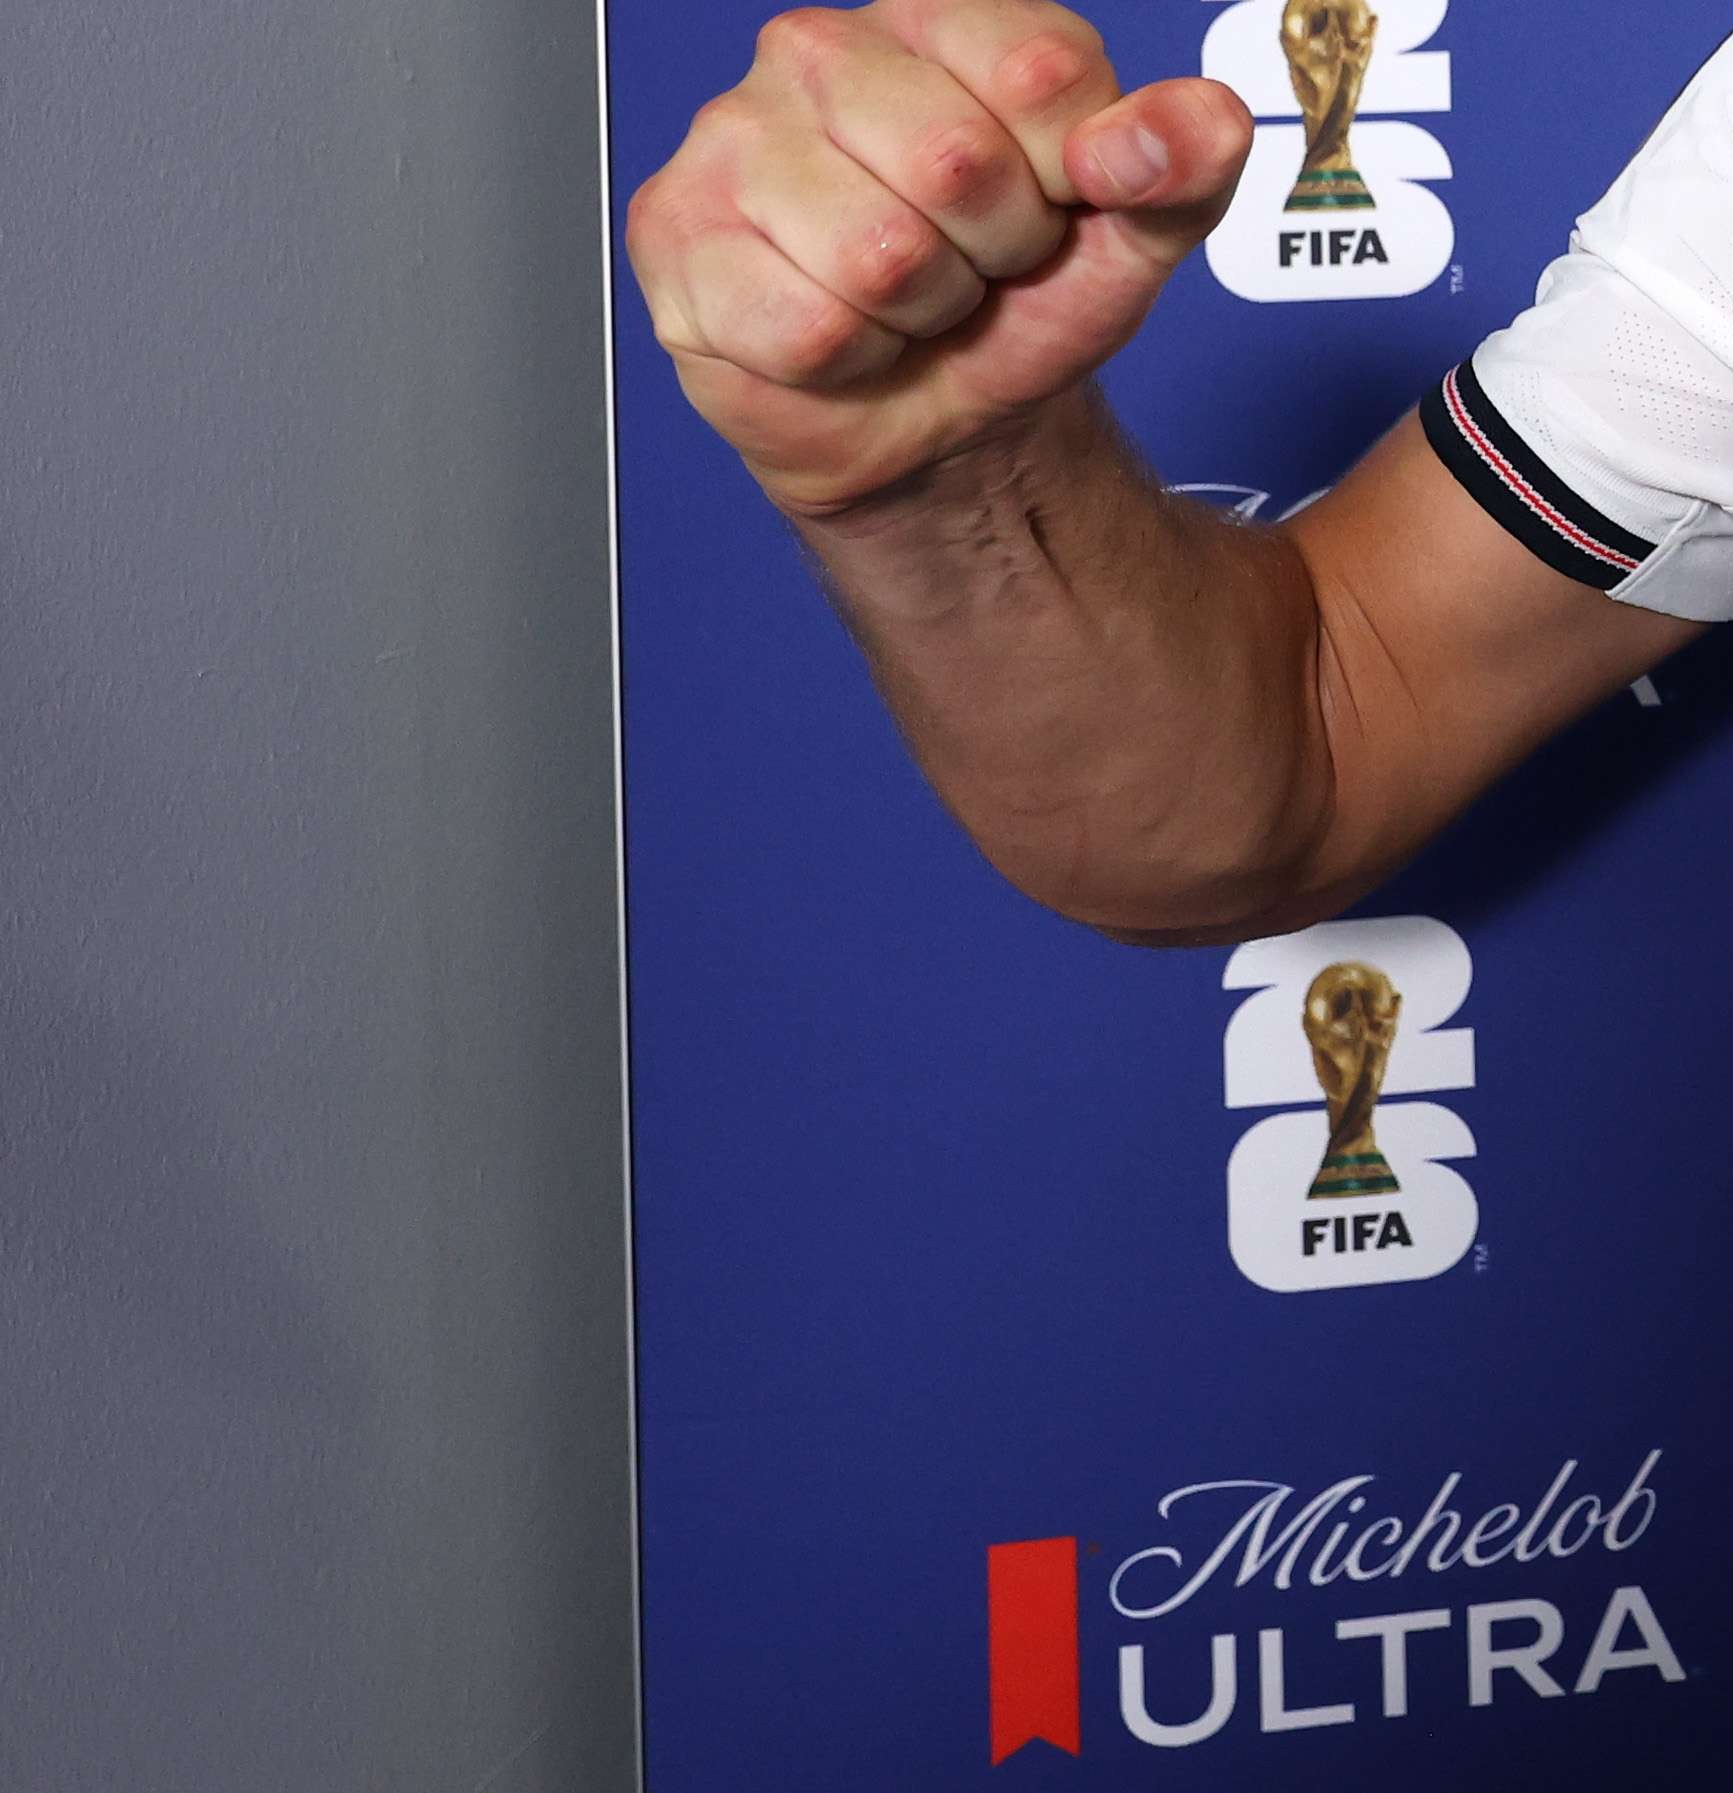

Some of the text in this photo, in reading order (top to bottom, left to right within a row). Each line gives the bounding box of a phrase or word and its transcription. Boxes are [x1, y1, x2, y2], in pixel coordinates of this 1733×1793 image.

[1278, 228, 1389, 268] FIFA
[1302, 1211, 1414, 1257] FIFA
[1109, 1449, 1662, 1619] Michelob
[1118, 1586, 1686, 1748] ULTRA
